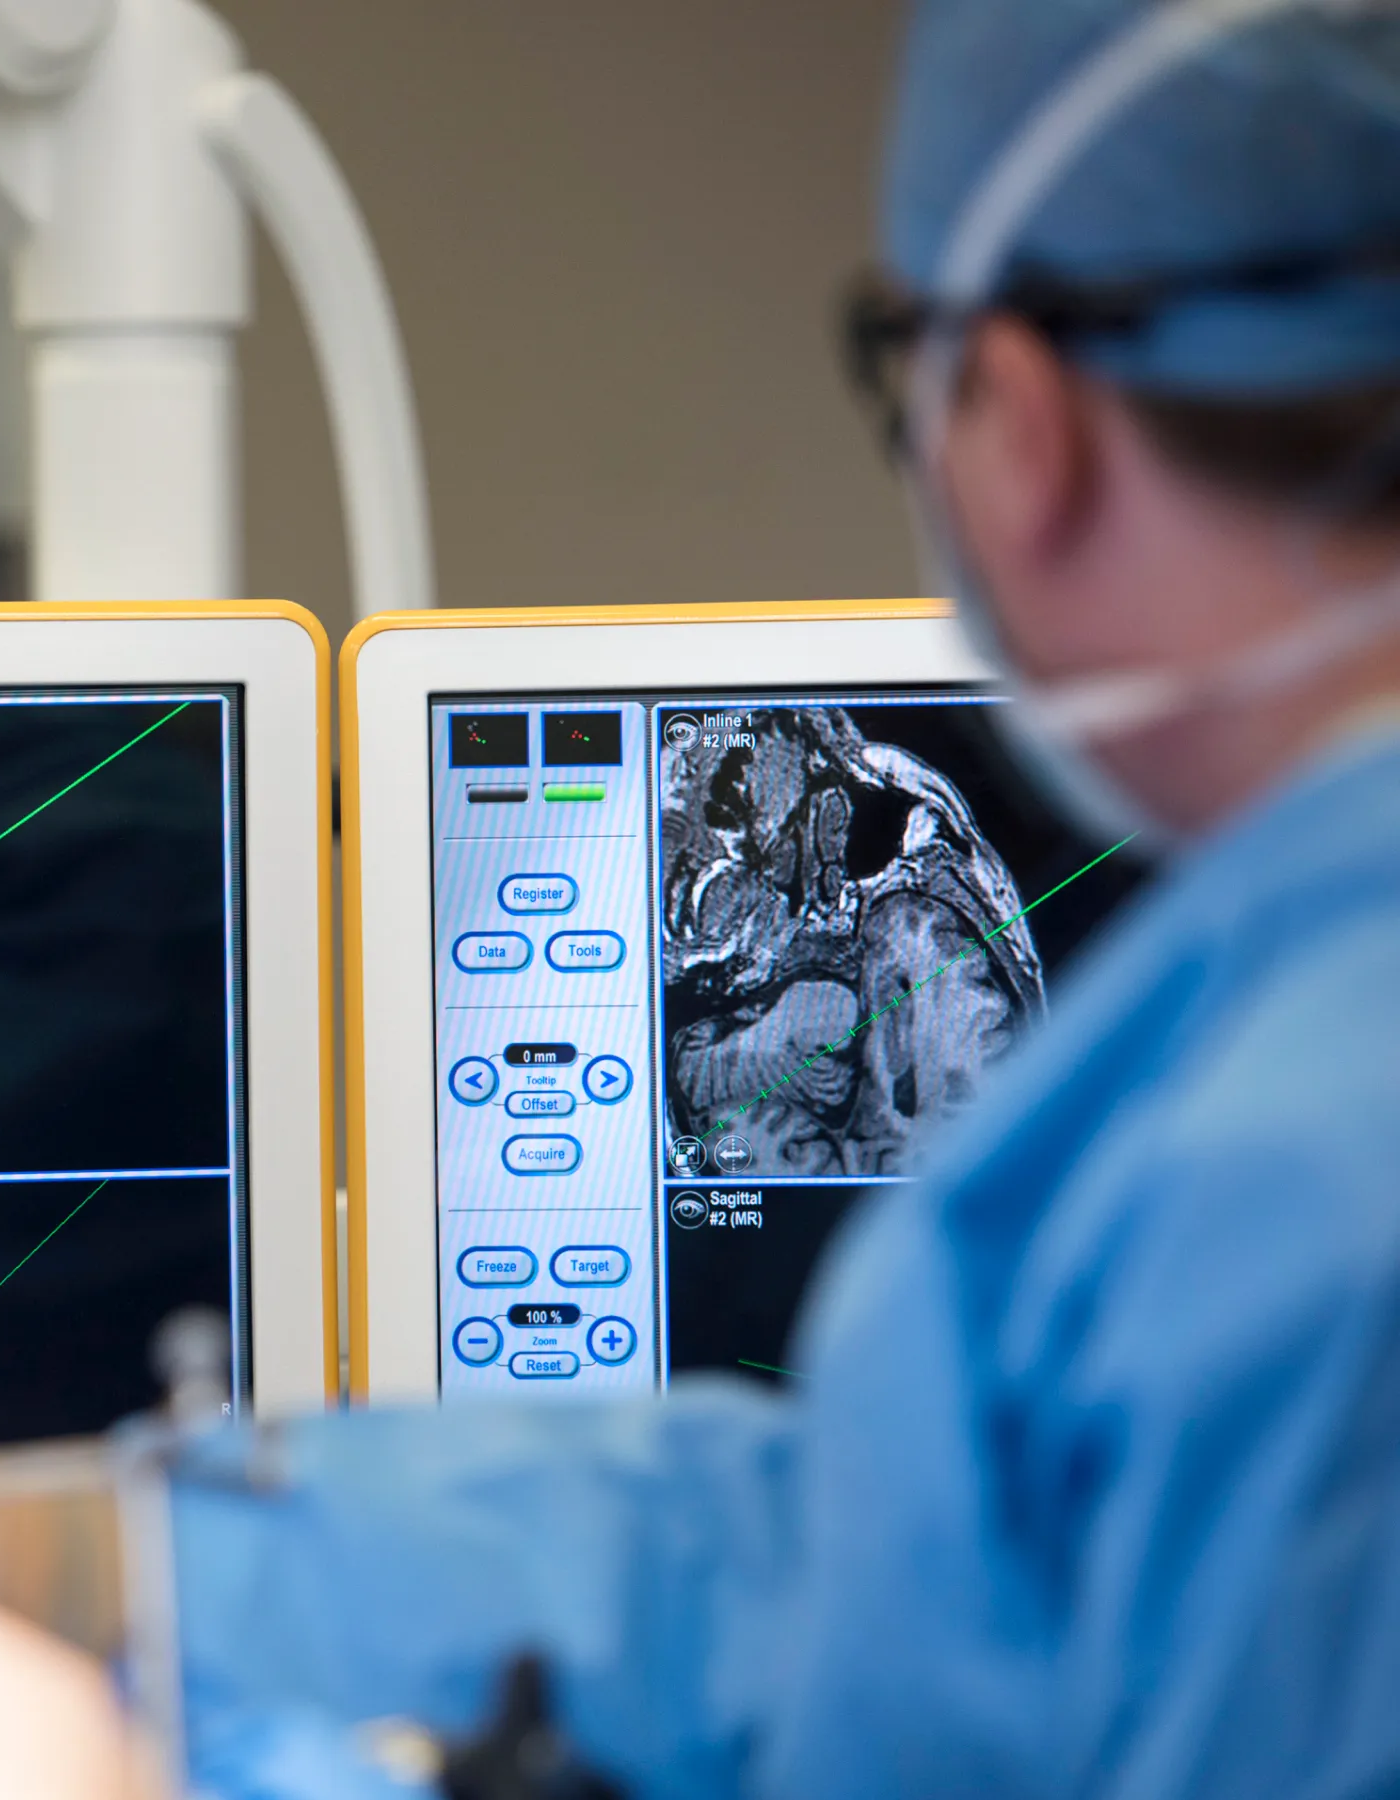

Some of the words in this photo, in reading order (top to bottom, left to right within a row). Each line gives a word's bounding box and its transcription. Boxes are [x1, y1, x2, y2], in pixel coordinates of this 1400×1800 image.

[703, 713, 742, 727] Inline
[746, 713, 752, 727] 1
[703, 735, 719, 748] #2
[724, 733, 756, 750] (MR)
[513, 887, 564, 902] Register
[479, 945, 506, 958] Data
[568, 944, 602, 957] Tools
[523, 1050, 531, 1063] 0
[534, 1052, 557, 1063] mm
[526, 1076, 556, 1086] Tooltip
[521, 1098, 559, 1111] Offset
[518, 1148, 565, 1162] Acquire
[710, 1191, 762, 1209] Sagittal
[710, 1212, 726, 1226] #2
[730, 1211, 763, 1229] (MR)
[476, 1260, 517, 1273] Freeze
[571, 1259, 609, 1274] Target
[526, 1311, 547, 1323] 100
[550, 1310, 563, 1324] %
[532, 1336, 558, 1346] Zoom
[526, 1359, 562, 1372] Reset
[221, 1403, 231, 1416] R
